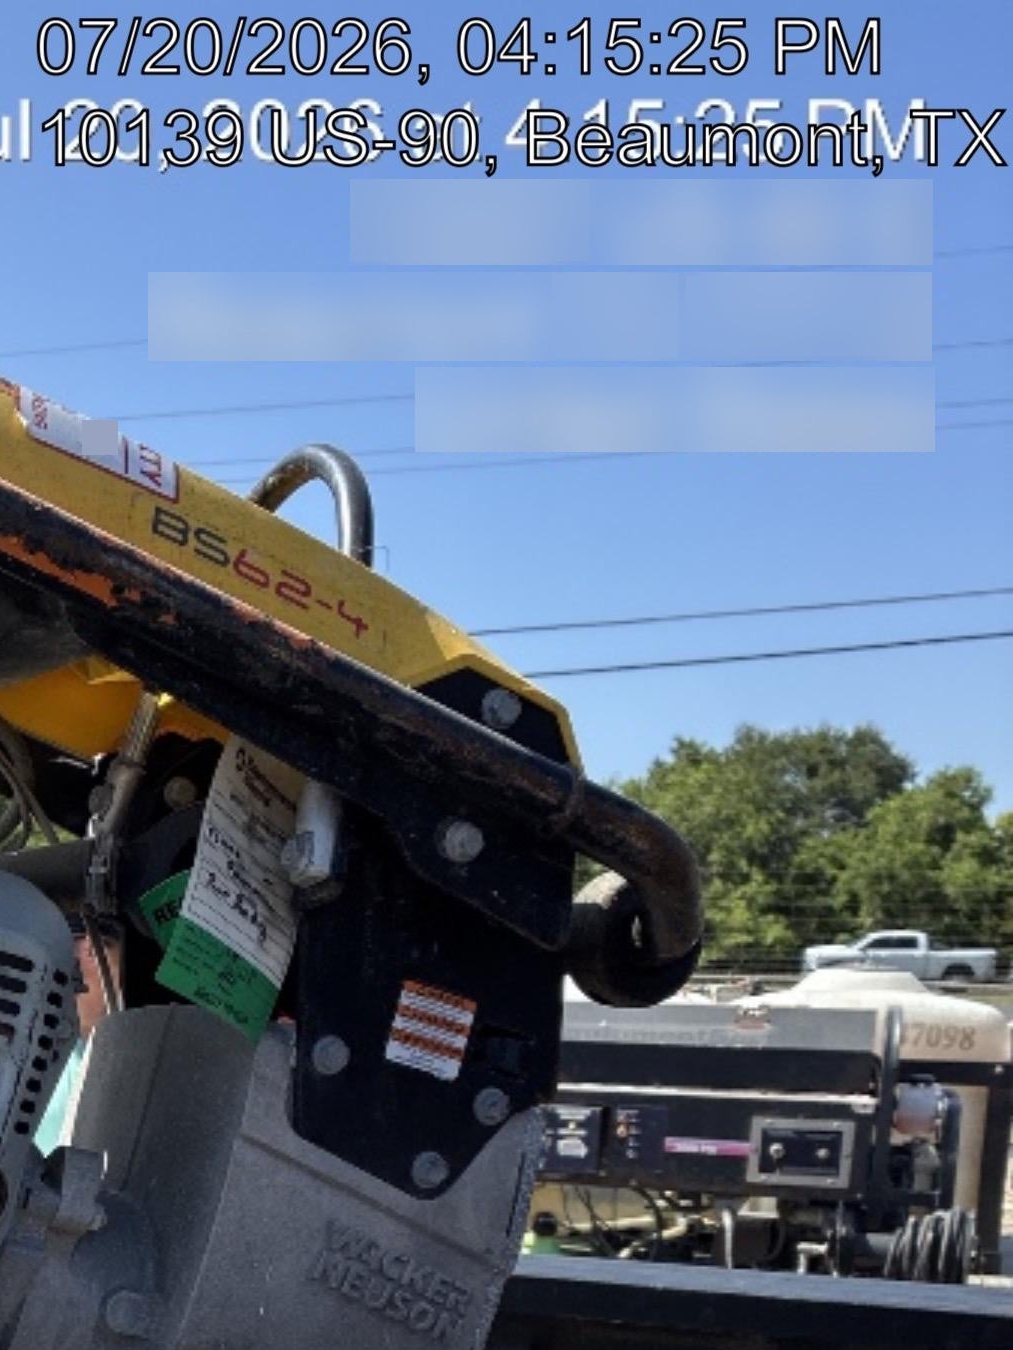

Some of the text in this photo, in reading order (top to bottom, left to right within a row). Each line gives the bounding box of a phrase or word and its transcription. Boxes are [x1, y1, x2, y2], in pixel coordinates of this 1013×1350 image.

[152, 506, 369, 639] BS62-4
[306, 1249, 465, 1342] NEUSON
[325, 1217, 470, 1319] WACKER
